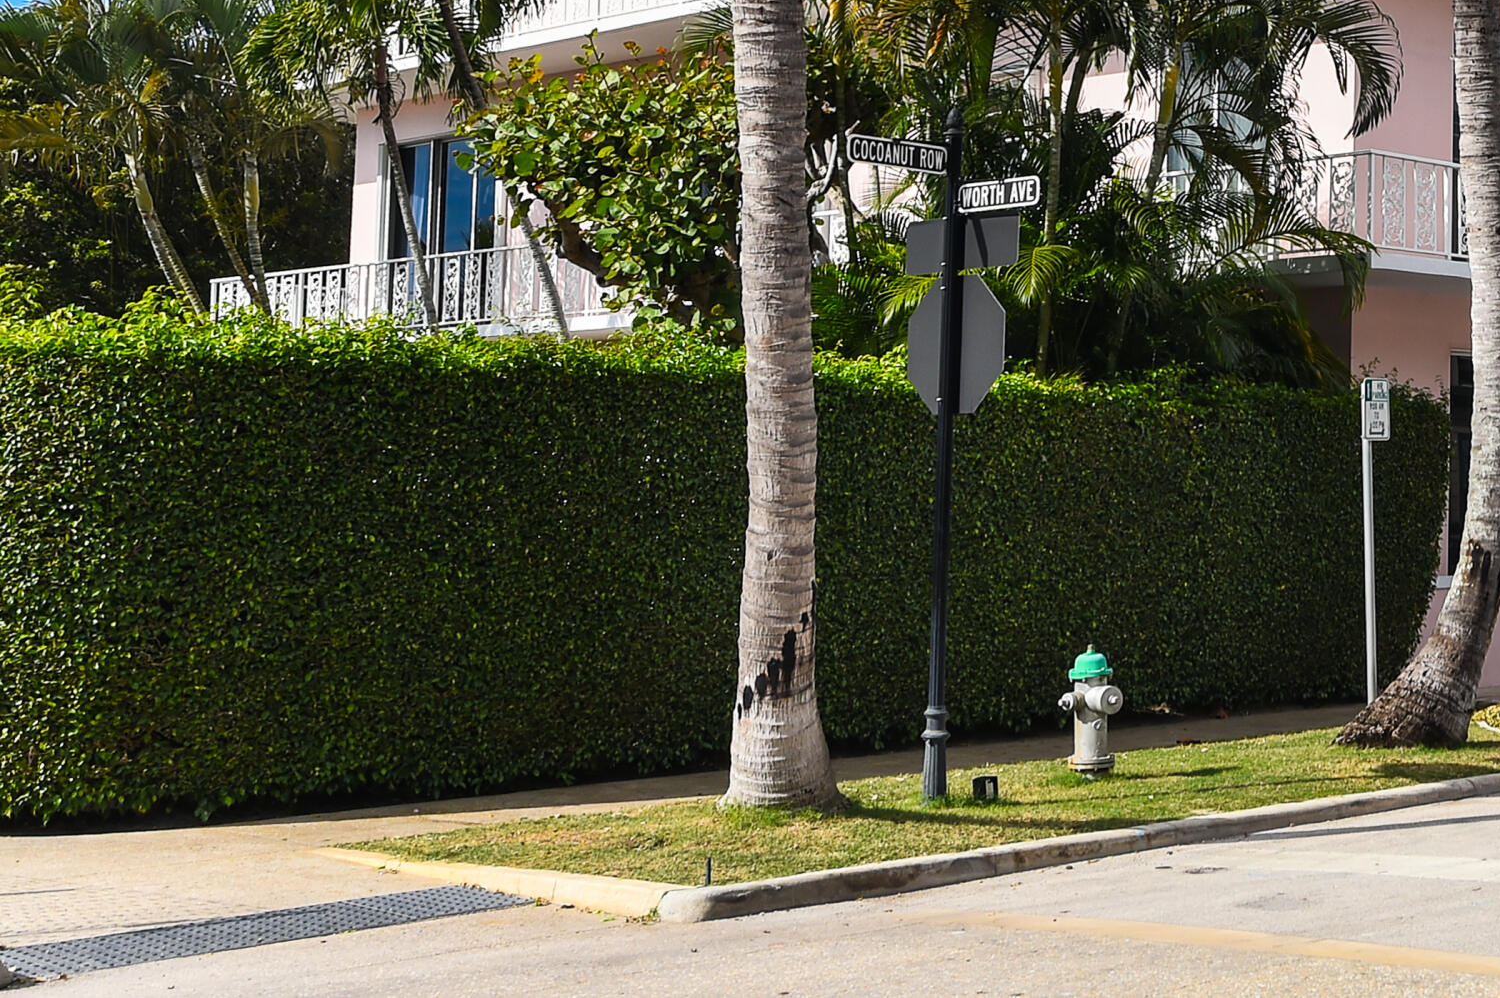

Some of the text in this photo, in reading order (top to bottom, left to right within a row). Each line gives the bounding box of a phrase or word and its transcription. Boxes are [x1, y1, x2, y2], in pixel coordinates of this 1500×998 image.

[853, 139, 943, 170] COCOANUT ROW
[962, 180, 1035, 208] WORTH AVE
